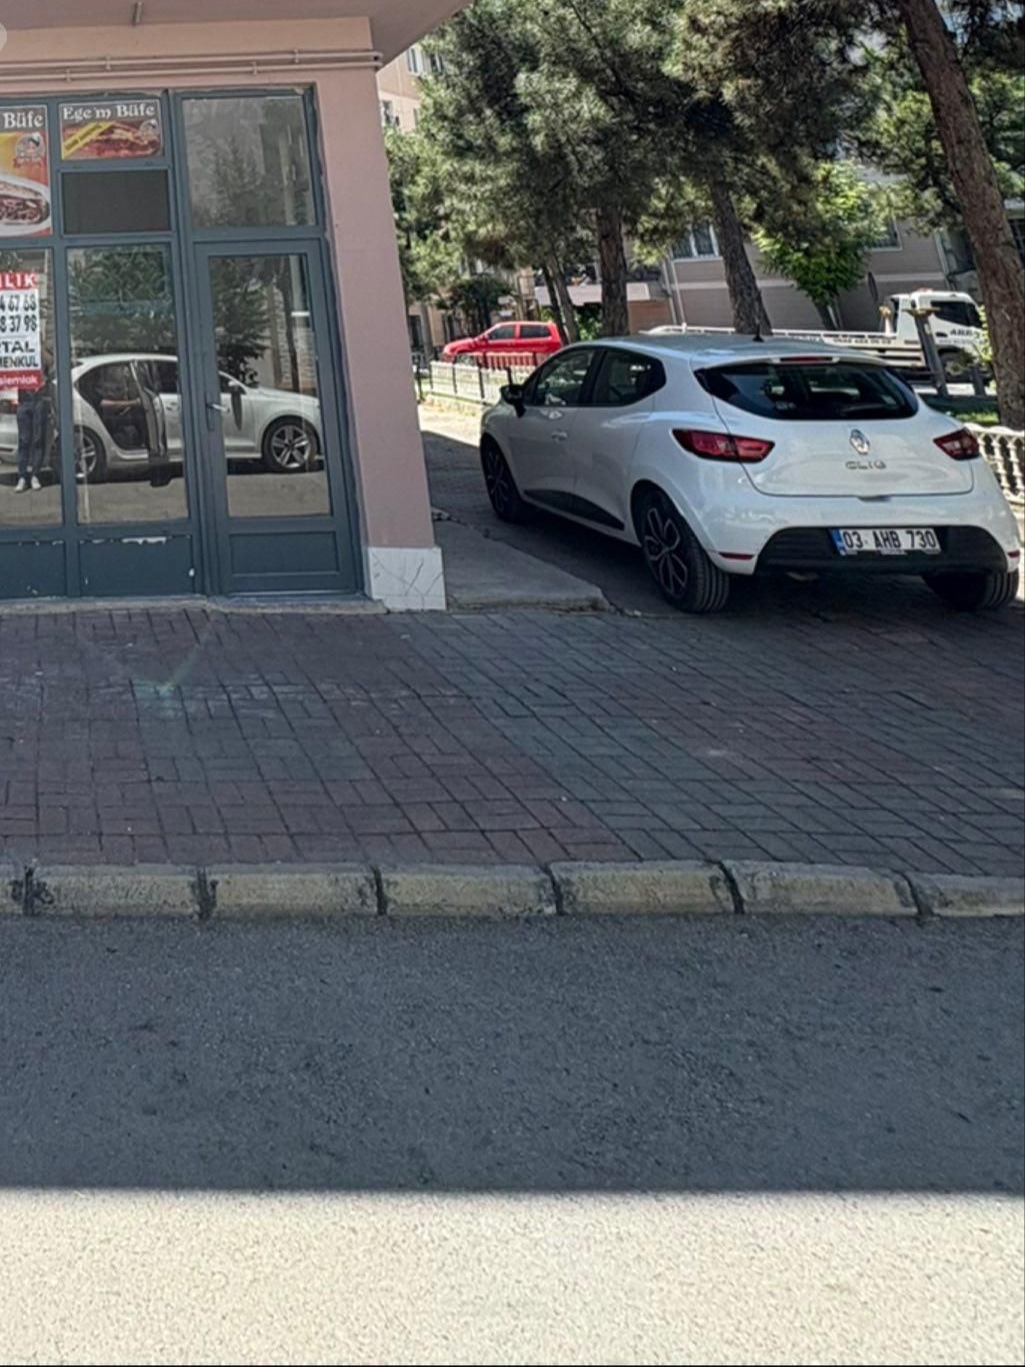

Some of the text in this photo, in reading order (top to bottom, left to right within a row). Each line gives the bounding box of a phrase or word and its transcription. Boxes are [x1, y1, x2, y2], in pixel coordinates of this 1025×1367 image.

[116, 102, 155, 118] Büfe
[3, 110, 44, 129] Büfe
[7, 294, 21, 312] 67
[23, 294, 37, 312] 68
[9, 315, 21, 332] 37
[24, 314, 37, 332] 98
[845, 460, 887, 470] CLIO
[842, 529, 937, 549] 03 AHB 730
